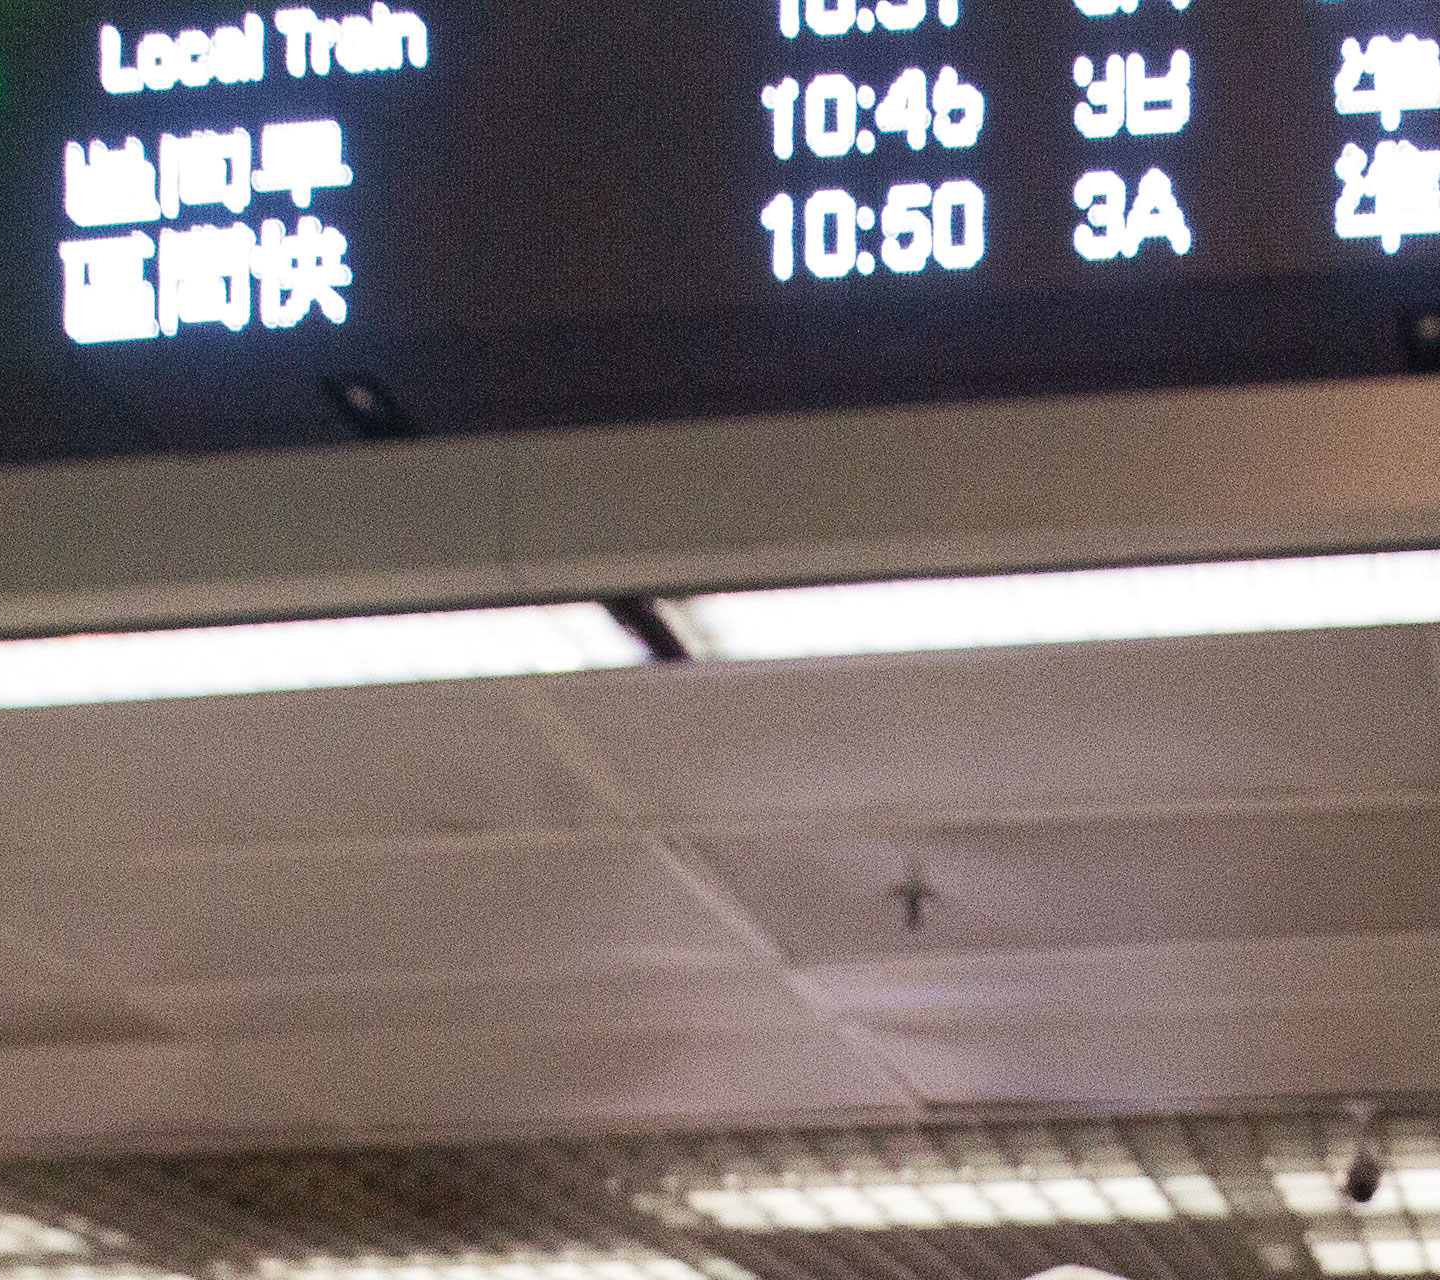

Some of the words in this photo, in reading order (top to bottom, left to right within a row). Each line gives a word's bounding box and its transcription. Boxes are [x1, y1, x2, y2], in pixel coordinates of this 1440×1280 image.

[98, 11, 265, 95] Local
[273, 0, 428, 78] Train
[760, 178, 985, 281] 10:50
[1073, 166, 1192, 262] 3A
